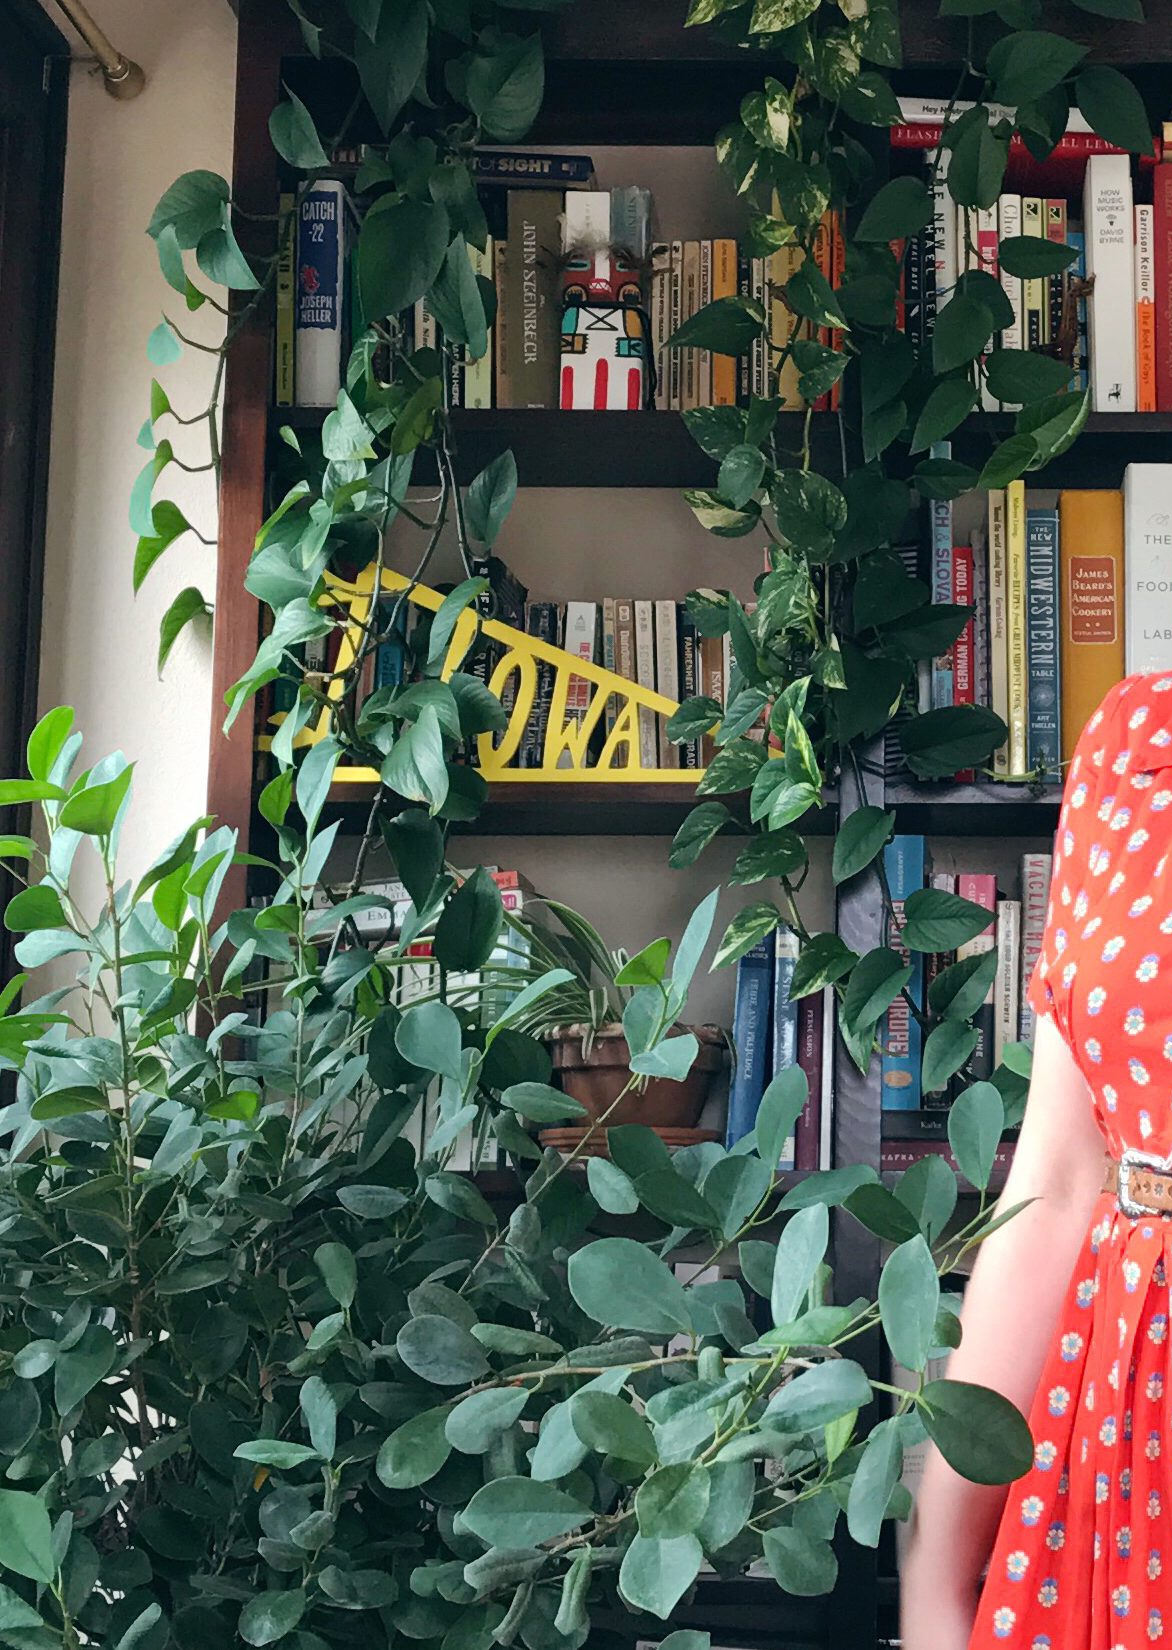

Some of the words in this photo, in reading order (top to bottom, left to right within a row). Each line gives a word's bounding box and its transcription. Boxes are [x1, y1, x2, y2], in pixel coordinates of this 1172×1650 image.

[498, 158, 552, 173] SIGHT
[1097, 197, 1124, 205] MUSIC
[1100, 189, 1120, 197] HOW
[302, 201, 336, 221] CATCH
[1003, 203, 1019, 235] Cho
[308, 223, 325, 243] -22
[934, 213, 946, 251] NEW
[1099, 228, 1124, 236] DAVID
[1140, 209, 1150, 253] Garrison
[521, 220, 538, 264] JOHN
[1140, 257, 1150, 292] Keillor
[299, 296, 333, 310] JOSEPH
[300, 309, 332, 324] HELLER
[521, 269, 539, 366] STEINBECK
[925, 290, 936, 338] LEWI
[1142, 329, 1151, 350] Book
[936, 532, 950, 542] &
[1030, 533, 1053, 541] NEW
[1143, 534, 1172, 545] THE
[935, 548, 951, 604] SLOVA
[956, 558, 968, 592] TODAY
[1012, 553, 1020, 579] Favorite
[1076, 568, 1109, 579] JAMES
[1012, 580, 1021, 610] RECIPES
[1072, 579, 1113, 590] BEARD'S
[1030, 546, 1054, 664] MIDWESTERN
[1072, 593, 1115, 603] AMERICAN
[1072, 606, 1112, 616] COOKERY
[1143, 629, 1172, 640] LAB
[684, 636, 694, 690] FAHRENHEIT
[956, 644, 969, 690] GERMAN
[1004, 944, 1013, 962] GOOD
[1003, 963, 1012, 992] SOLDIER
[749, 978, 759, 1006] PRIDE
[748, 1007, 757, 1029] AND
[806, 1009, 814, 1058] PERSUASION
[743, 1031, 757, 1081] PREJUDICE
[920, 1120, 942, 1129] Kafka
[881, 1153, 914, 1161] KAFKA
